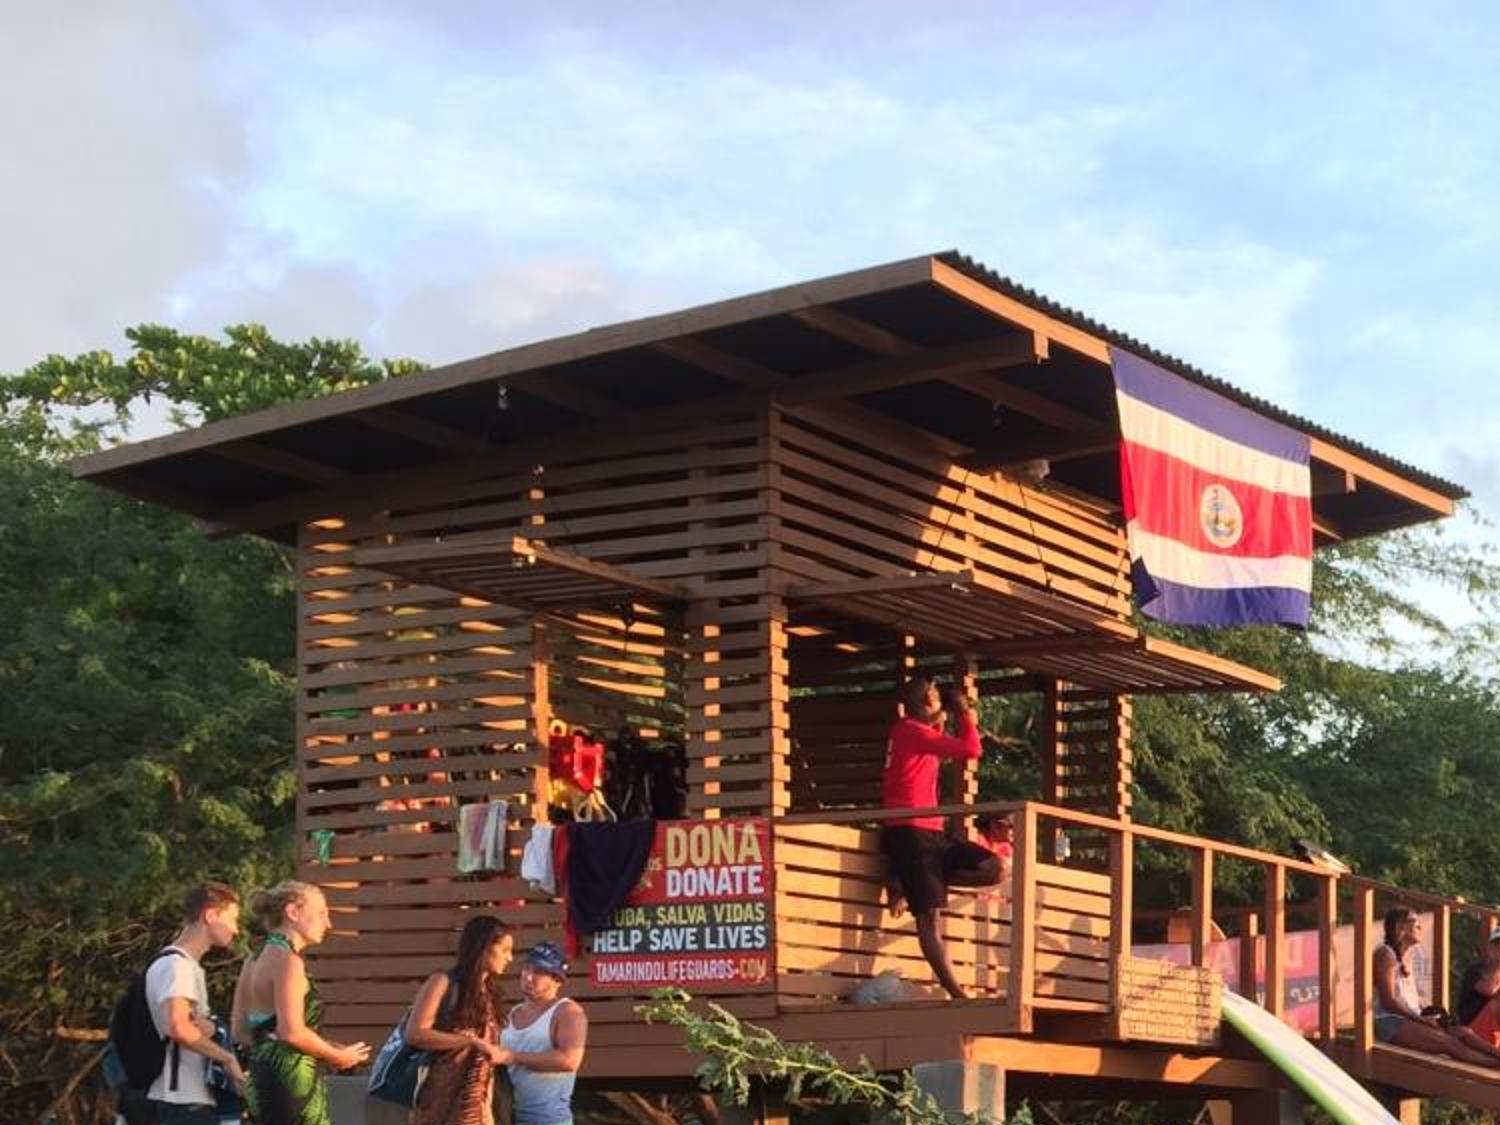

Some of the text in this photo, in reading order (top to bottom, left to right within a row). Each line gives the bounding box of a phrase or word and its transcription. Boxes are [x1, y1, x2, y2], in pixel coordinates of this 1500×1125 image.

[666, 824, 762, 866] DONA
[667, 864, 765, 897] DONATE
[609, 902, 765, 929] UDA, SALVA VIDAS
[593, 924, 767, 953] HELP SAVE LIVES
